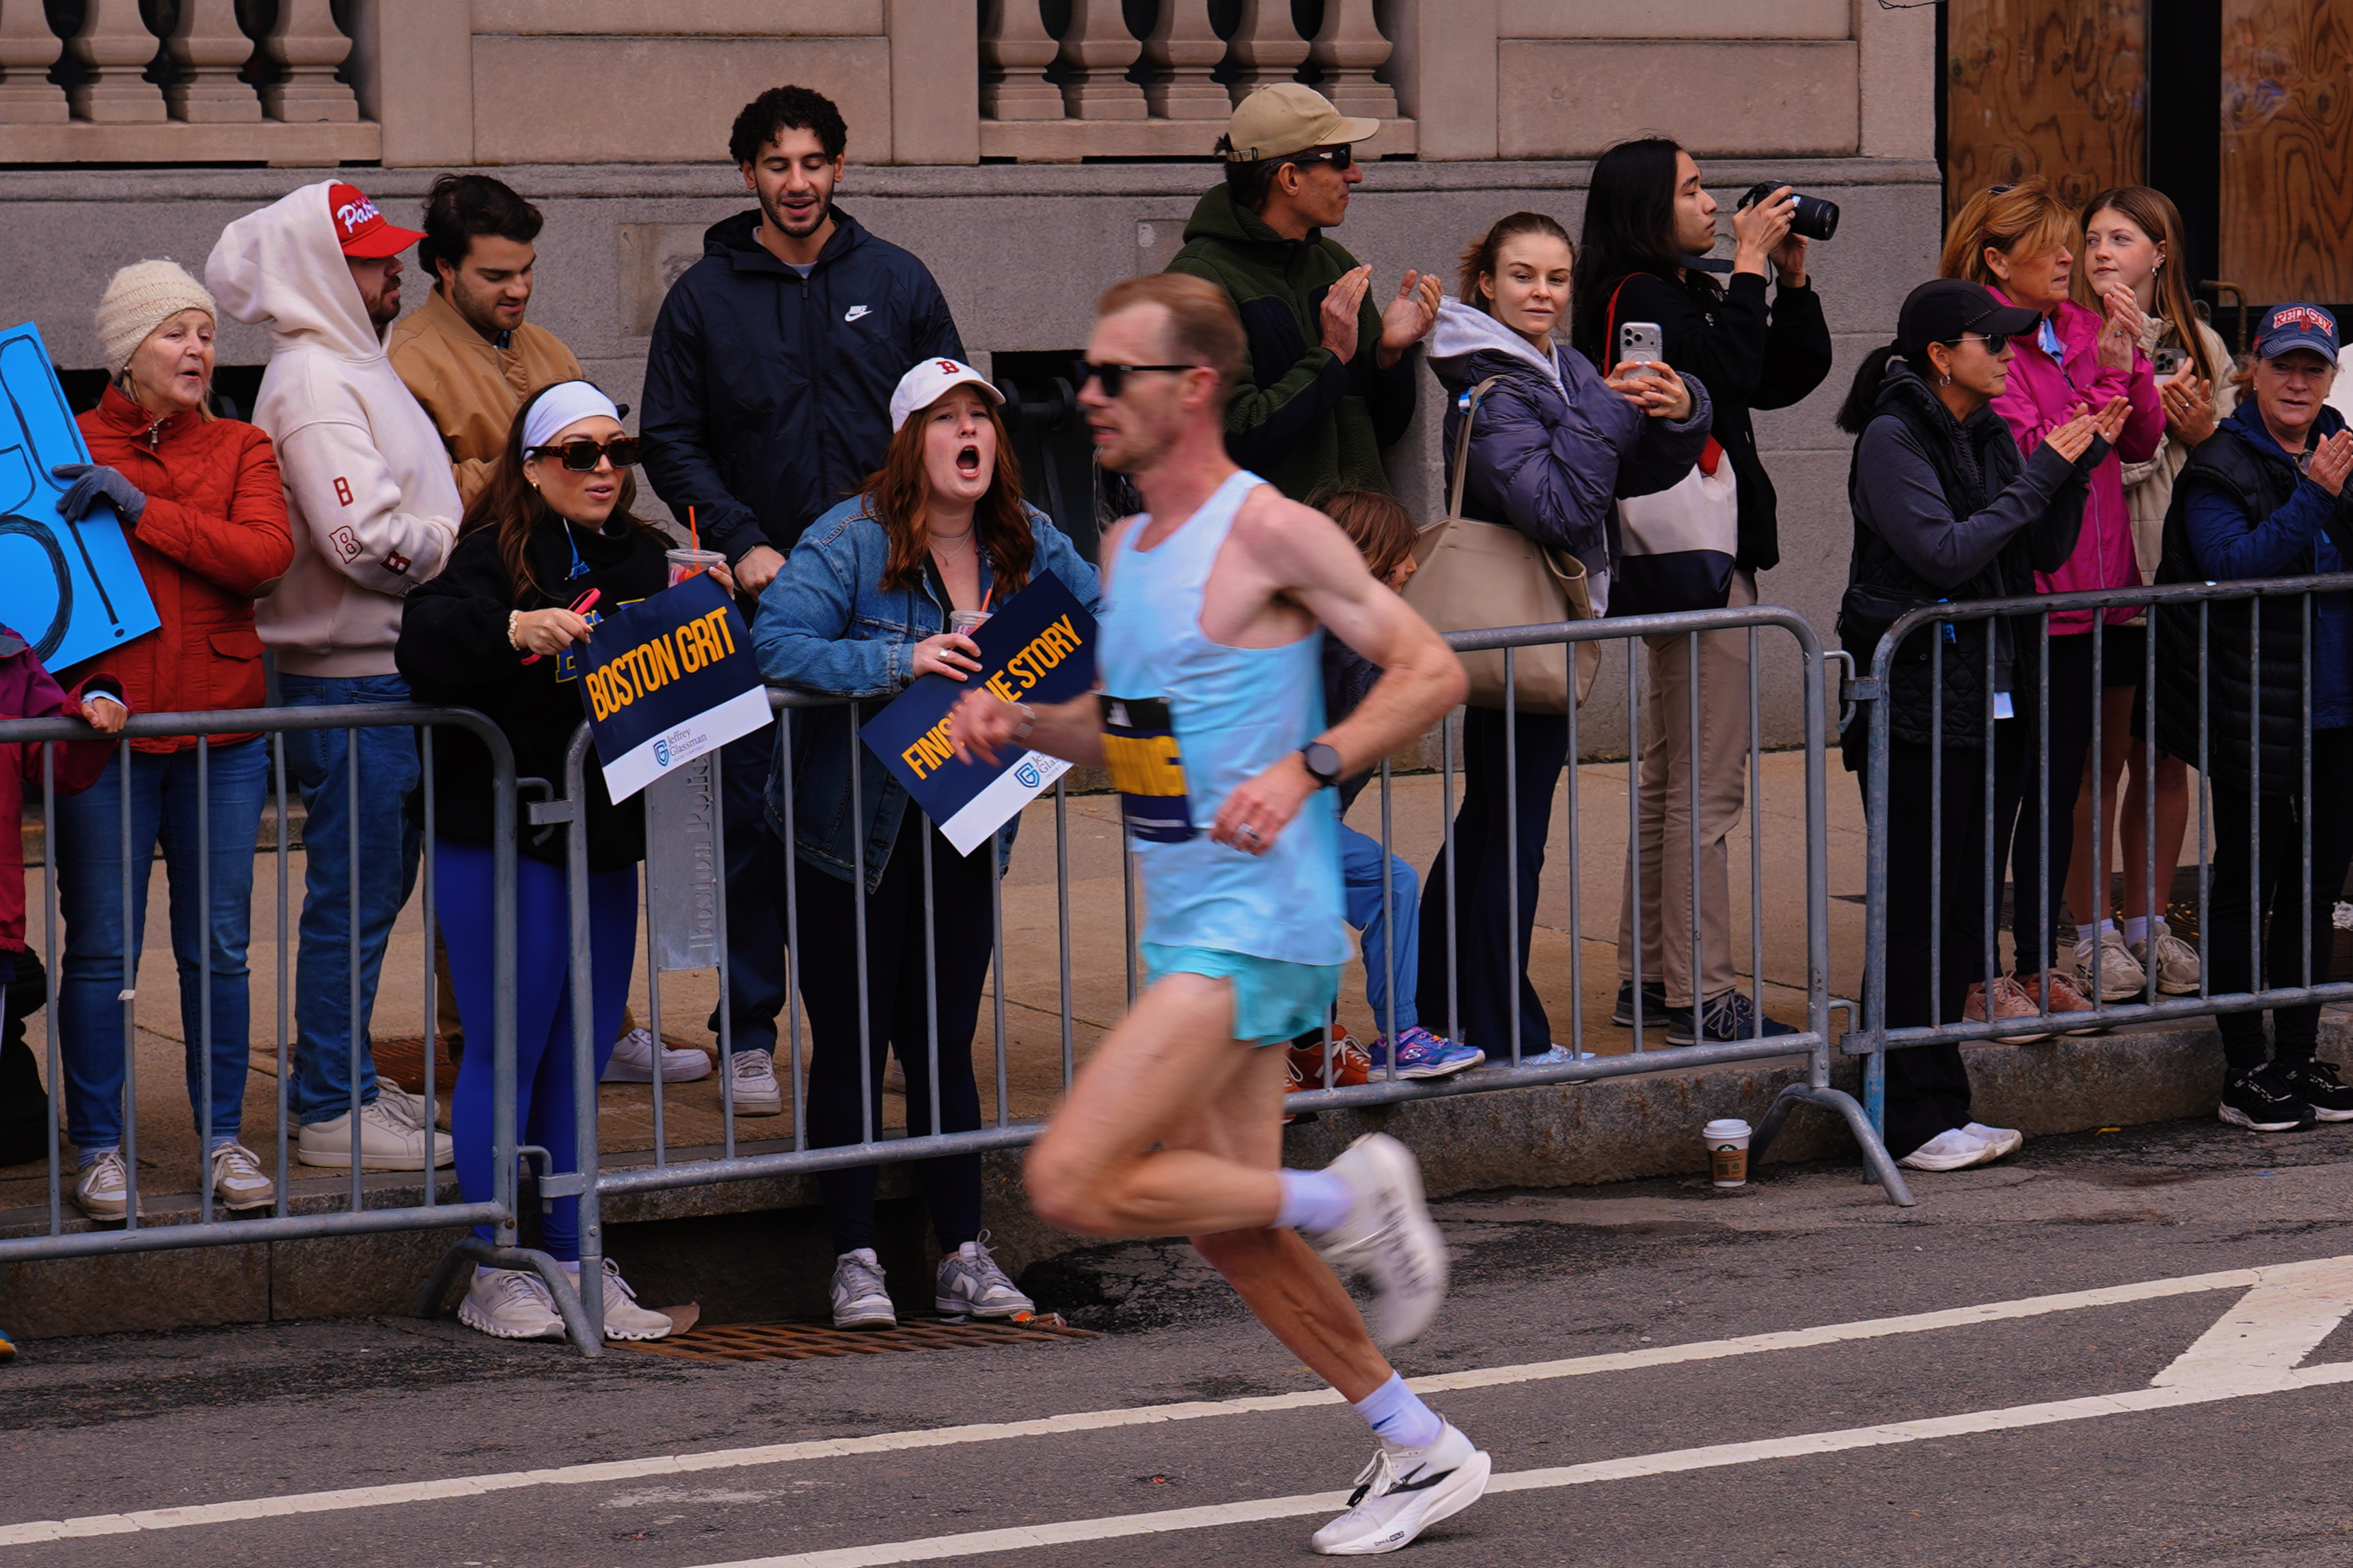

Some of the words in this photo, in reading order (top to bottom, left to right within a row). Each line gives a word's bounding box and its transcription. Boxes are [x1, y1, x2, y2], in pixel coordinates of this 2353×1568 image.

[2273, 307, 2305, 329] RED
[2307, 308, 2334, 337] SOX
[936, 361, 960, 374] B
[333, 476, 353, 507] B
[329, 525, 364, 564] B
[380, 551, 411, 576] B
[585, 634, 680, 722] BOSTON
[675, 606, 735, 674] GRIT
[901, 704, 965, 780] FINIS
[1007, 614, 1083, 689] STORY
[667, 728, 691, 747] Jeffrey
[669, 734, 707, 756] Glassman
[686, 757, 709, 833] Polic
